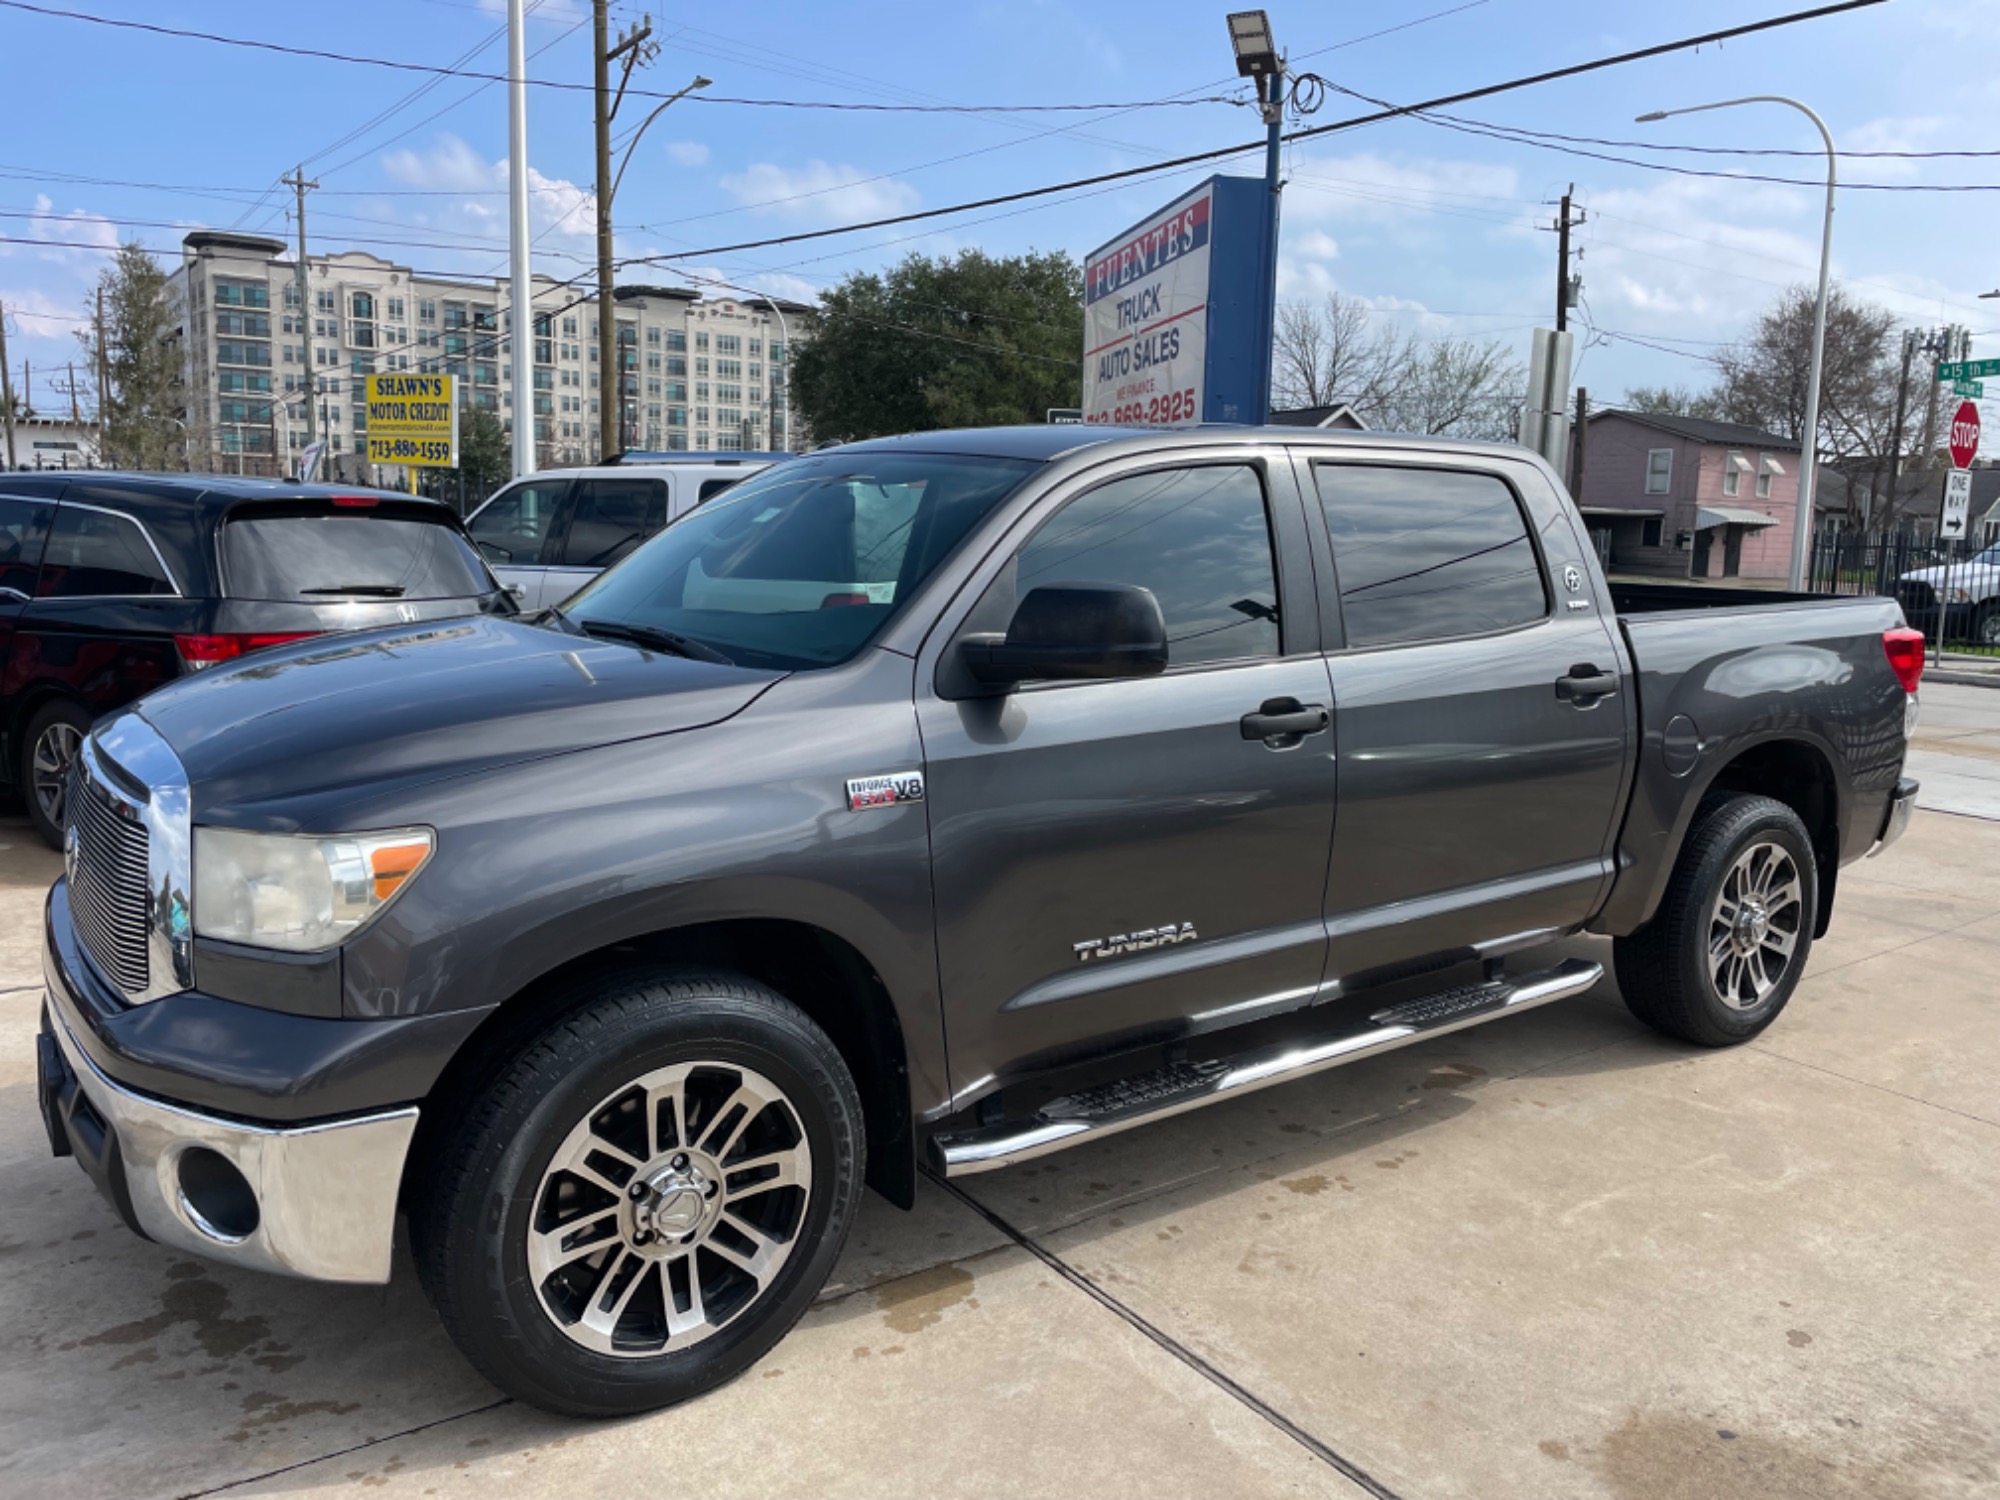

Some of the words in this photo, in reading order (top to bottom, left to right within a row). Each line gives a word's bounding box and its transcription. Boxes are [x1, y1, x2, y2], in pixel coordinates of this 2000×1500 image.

[1095, 209, 1194, 299] FUENTES
[1116, 282, 1161, 330] TRUCK
[1098, 350, 1130, 383] AUTO
[1132, 328, 1180, 372] SALES
[1951, 364, 1963, 378] 15
[1968, 362, 1982, 376] th
[377, 378, 441, 397] SHAWN'S
[370, 402, 407, 420] MOTOR
[410, 403, 449, 421] CREDIT
[1952, 421, 1979, 448] STOP
[371, 439, 449, 460] 713-880-1559
[1952, 475, 1968, 491] ONE
[1948, 494, 1967, 510] WAY
[895, 779, 922, 800] V8
[1072, 921, 1198, 961] TUNDRA
